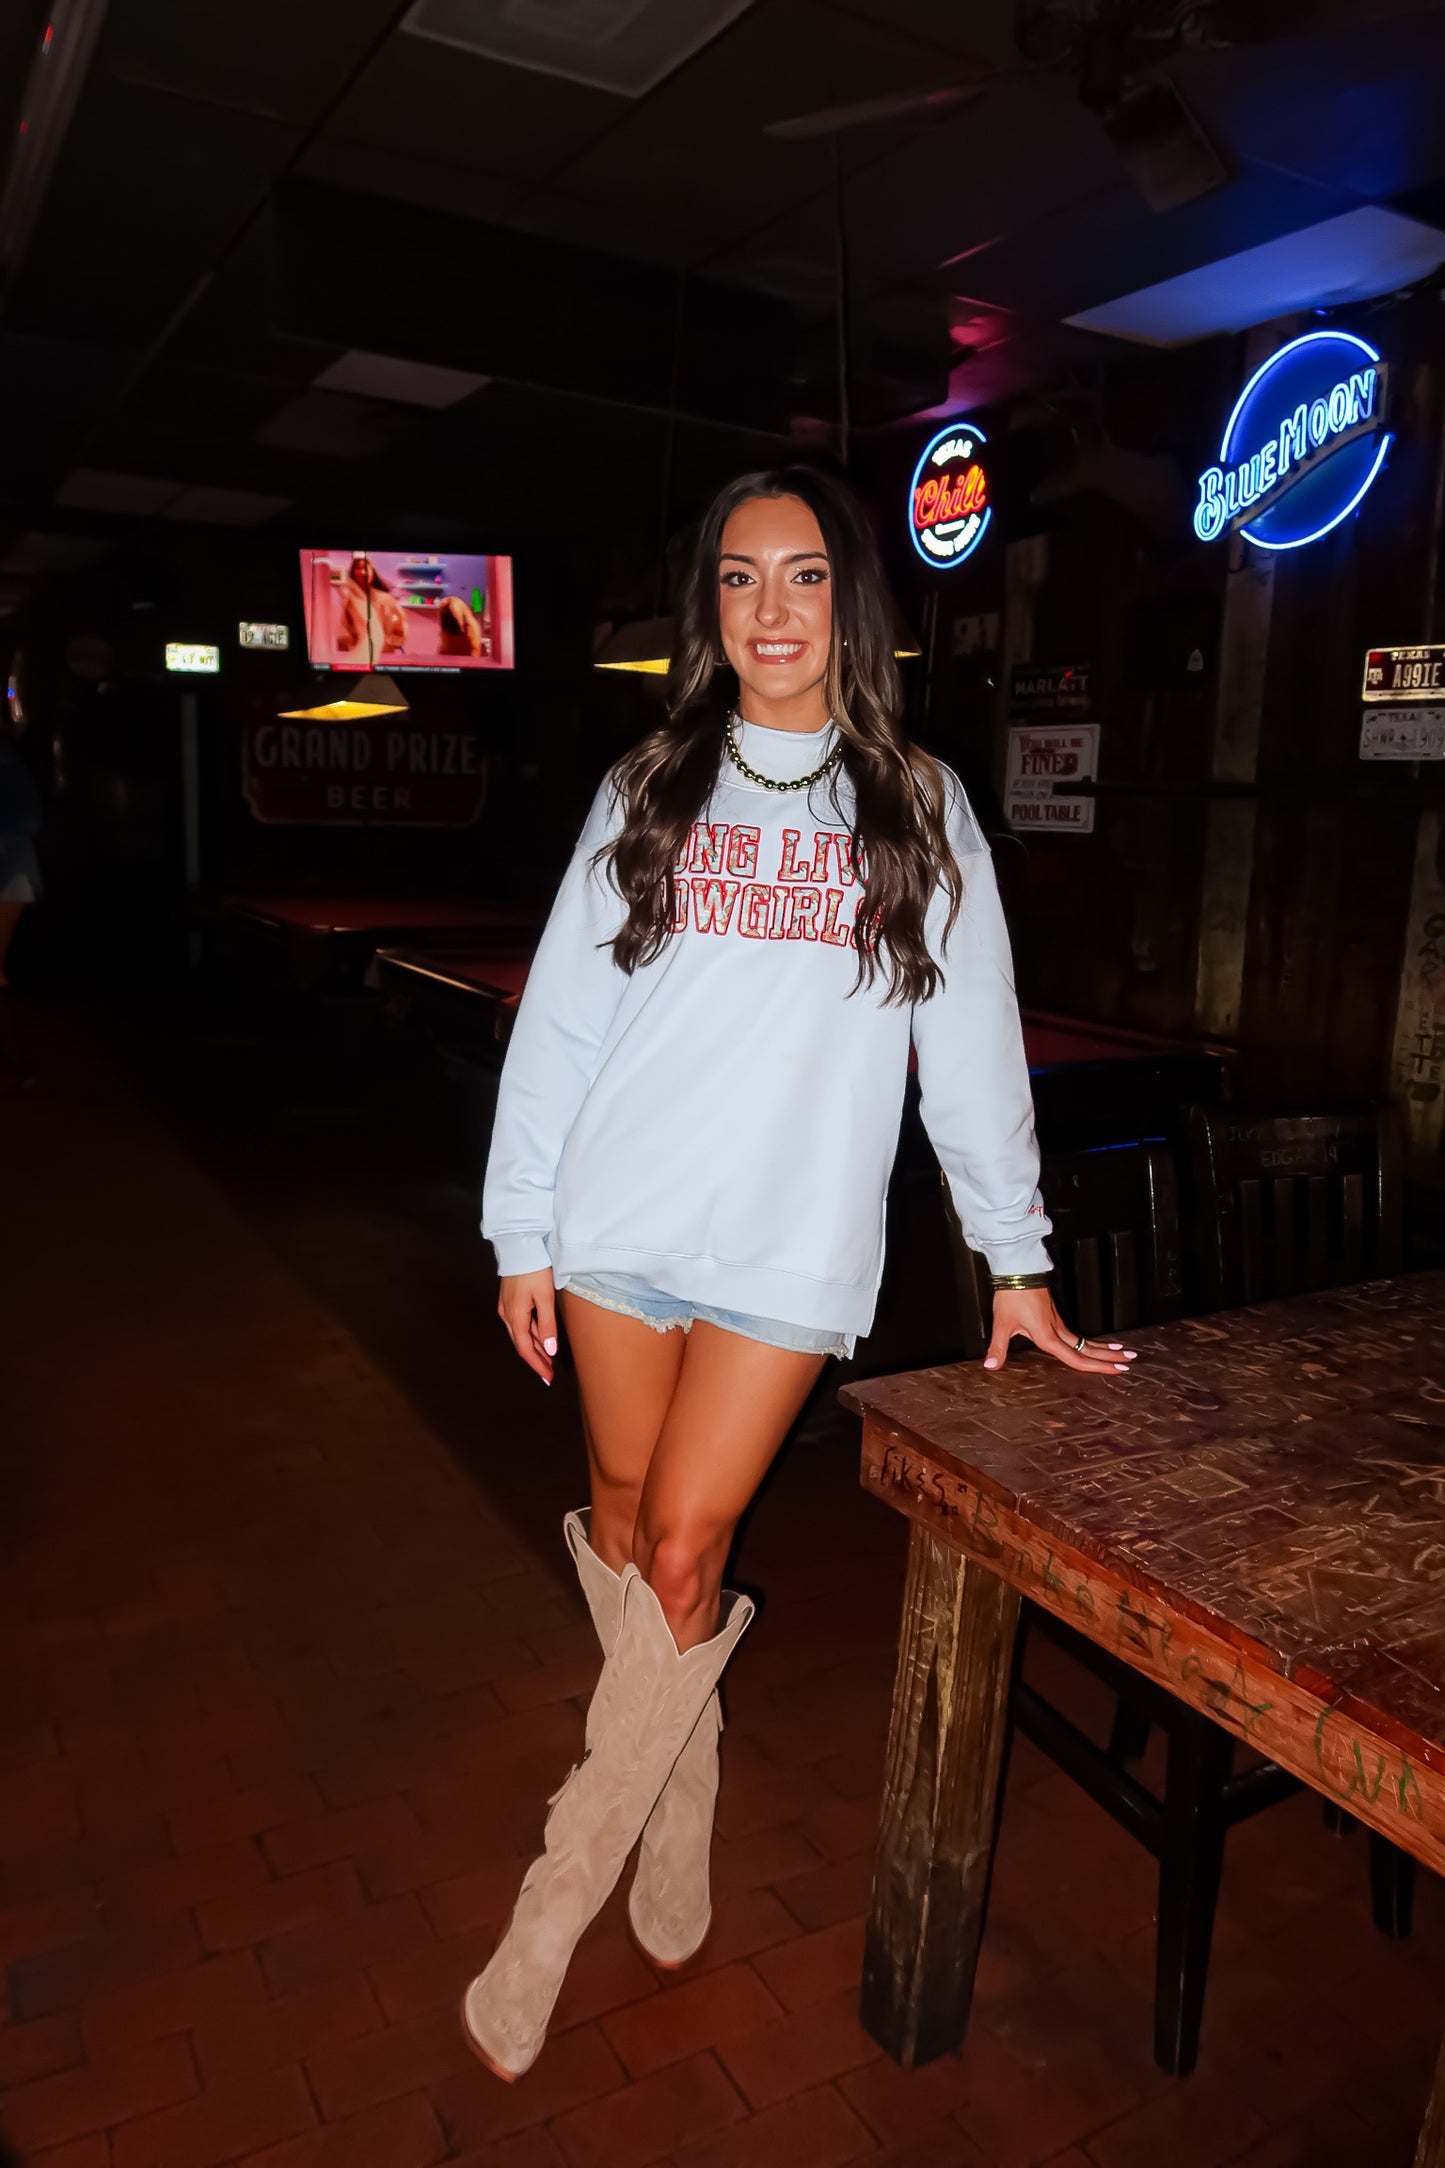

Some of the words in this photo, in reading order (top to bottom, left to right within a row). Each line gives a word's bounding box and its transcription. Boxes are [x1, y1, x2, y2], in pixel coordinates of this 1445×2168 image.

[1194, 440, 1277, 541] BLUE
[1277, 368, 1377, 476] MOON
[914, 465, 986, 529] Chill
[254, 724, 373, 772] GRAND
[386, 731, 478, 775] PRIZE
[326, 784, 412, 810] BEER
[1012, 804, 1042, 821] POOL
[1044, 804, 1081, 822] TABLE
[674, 822, 761, 879] NG
[777, 829, 869, 886] LIV
[660, 876, 885, 951] OWGIRL
